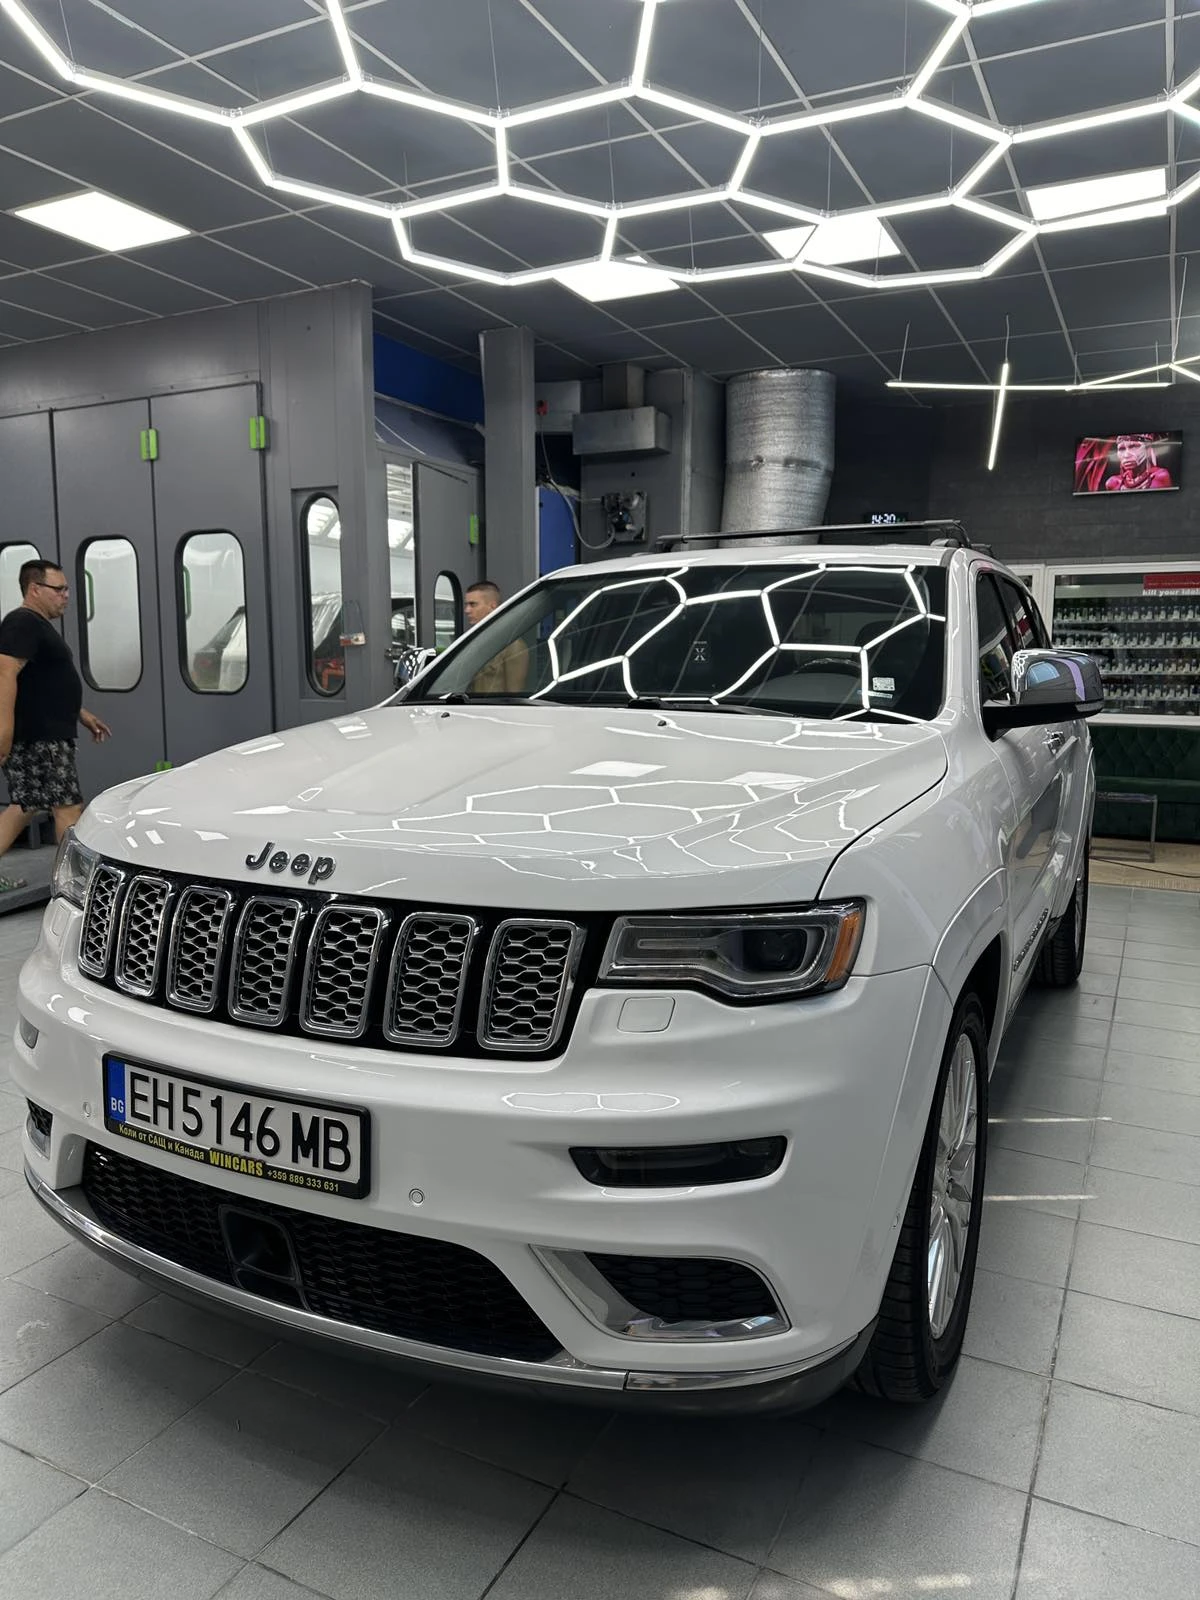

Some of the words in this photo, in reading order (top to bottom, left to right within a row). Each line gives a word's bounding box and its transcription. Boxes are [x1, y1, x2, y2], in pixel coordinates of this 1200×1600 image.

[245, 842, 336, 885] Jeep
[110, 1097, 124, 1113] BG
[119, 1123, 137, 1137] Коли
[138, 1132, 147, 1141] от
[148, 1135, 166, 1149] САЩ
[174, 1143, 204, 1160] Канада
[209, 1149, 263, 1177] WINCARS
[267, 1169, 287, 1181] +359
[289, 1173, 304, 1185] 889
[306, 1177, 322, 1189] 333
[323, 1181, 339, 1192] 631
